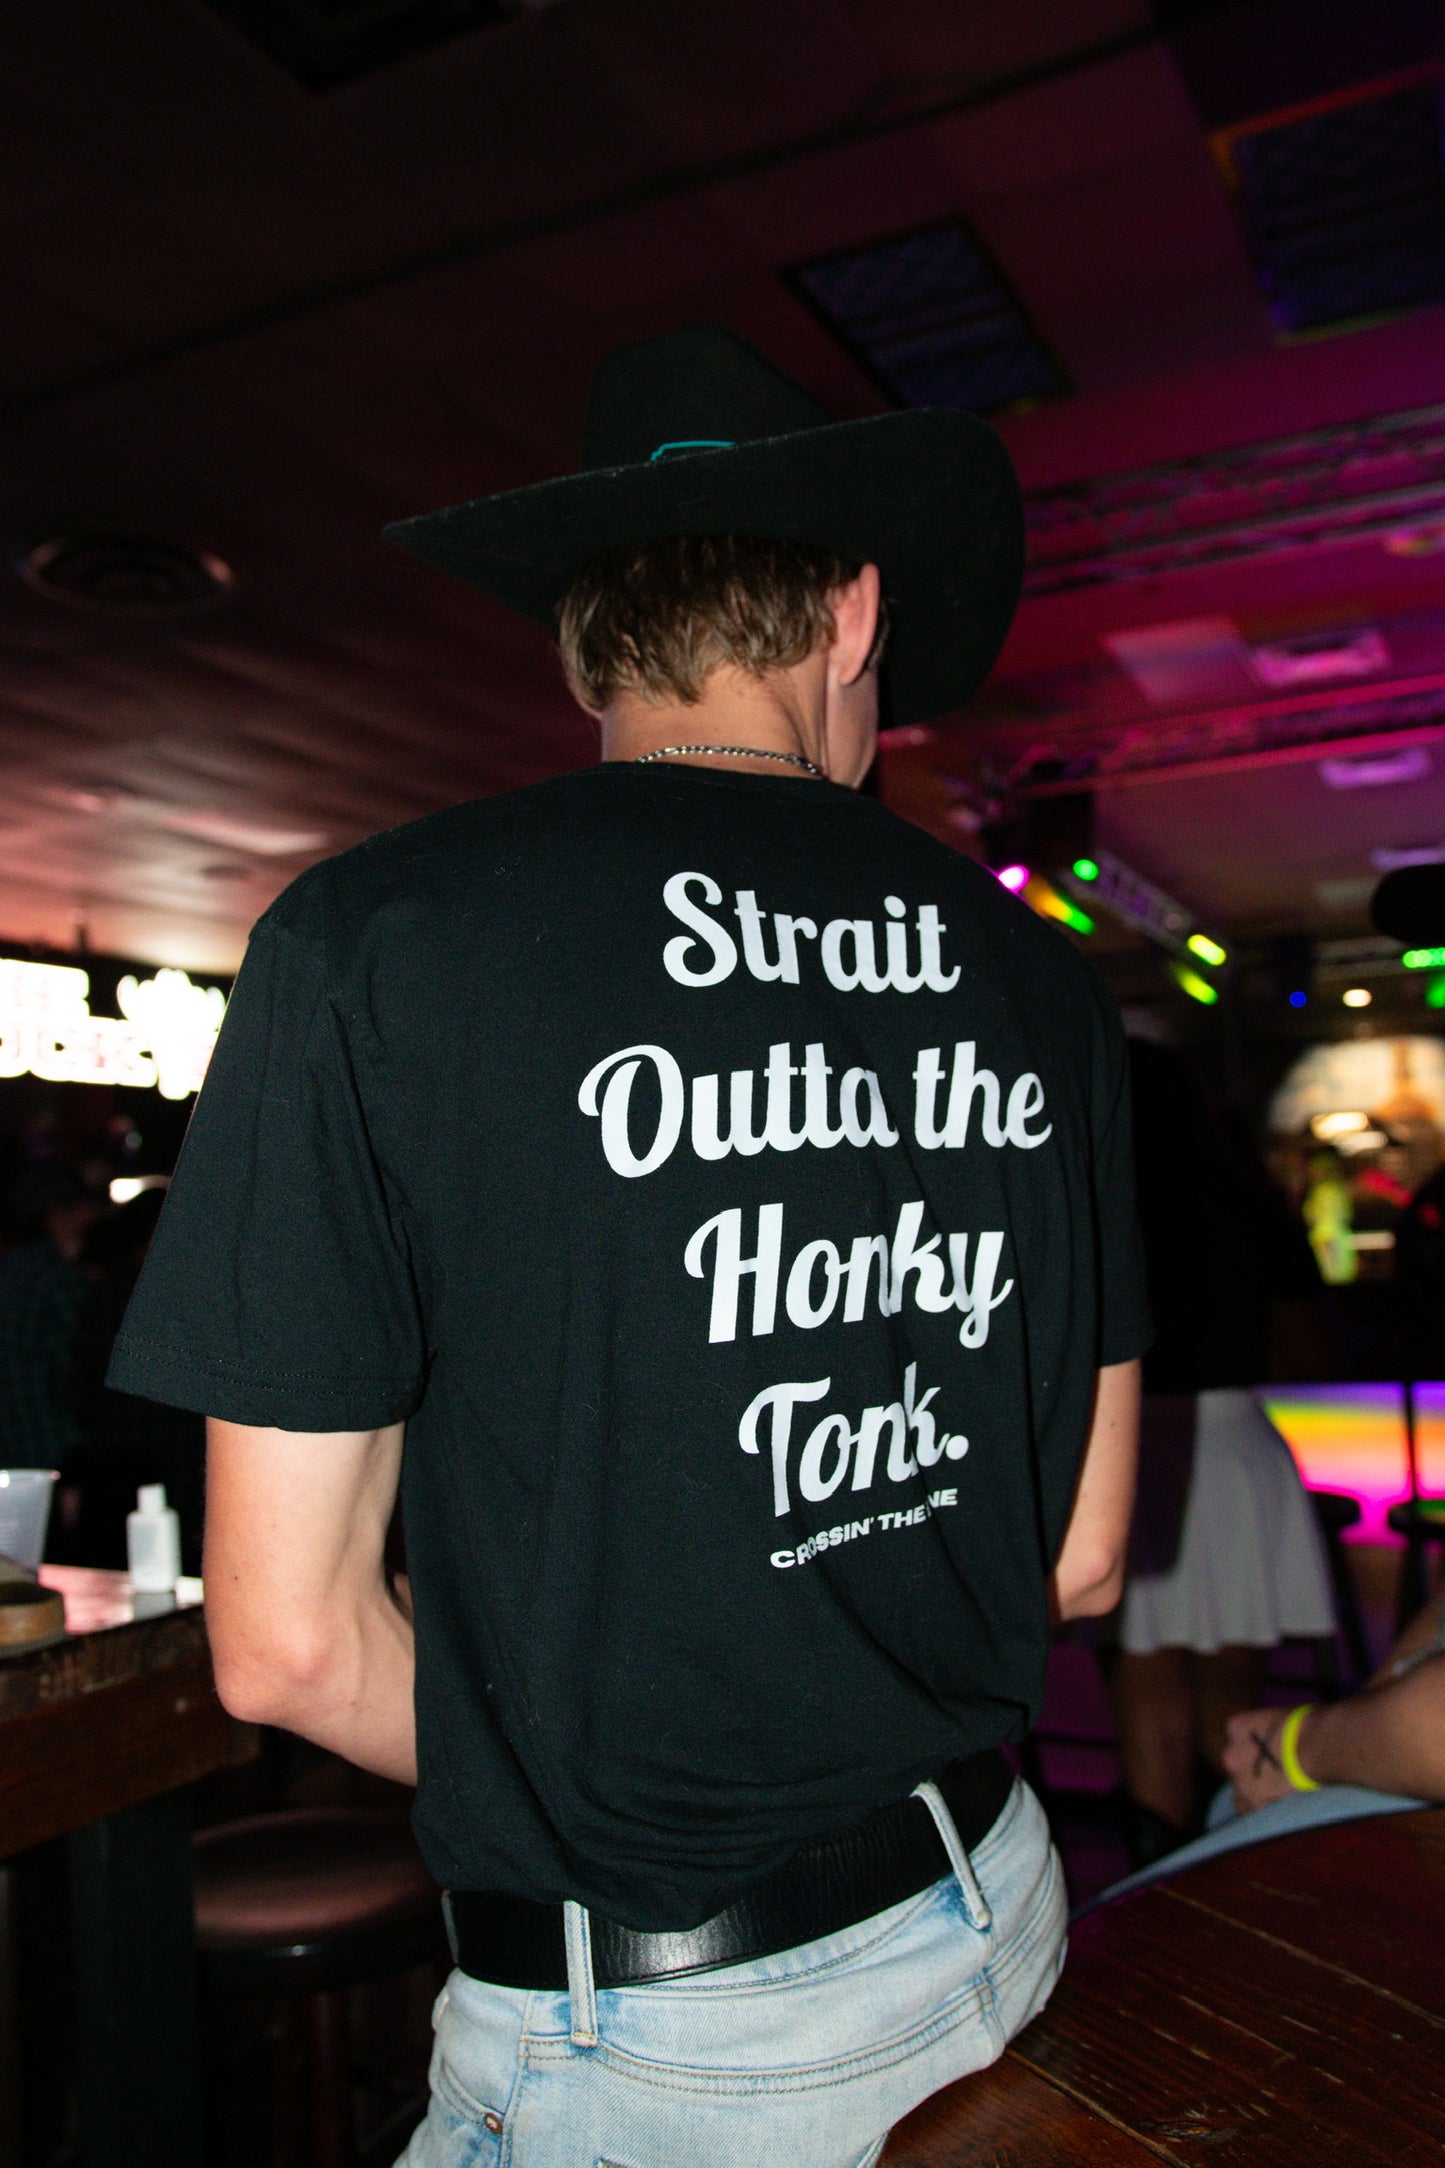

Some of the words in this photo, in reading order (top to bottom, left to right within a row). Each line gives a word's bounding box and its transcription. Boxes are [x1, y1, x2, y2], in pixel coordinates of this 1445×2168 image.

[662, 871, 962, 994] Strait
[577, 1041, 900, 1179] Outta
[912, 1040, 1053, 1150] the
[683, 1200, 1015, 1349] Honky
[738, 1361, 970, 1518] Tonk.
[769, 1516, 875, 1569] CROSSIN'
[877, 1505, 927, 1531] THE
[926, 1488, 958, 1517] NE
